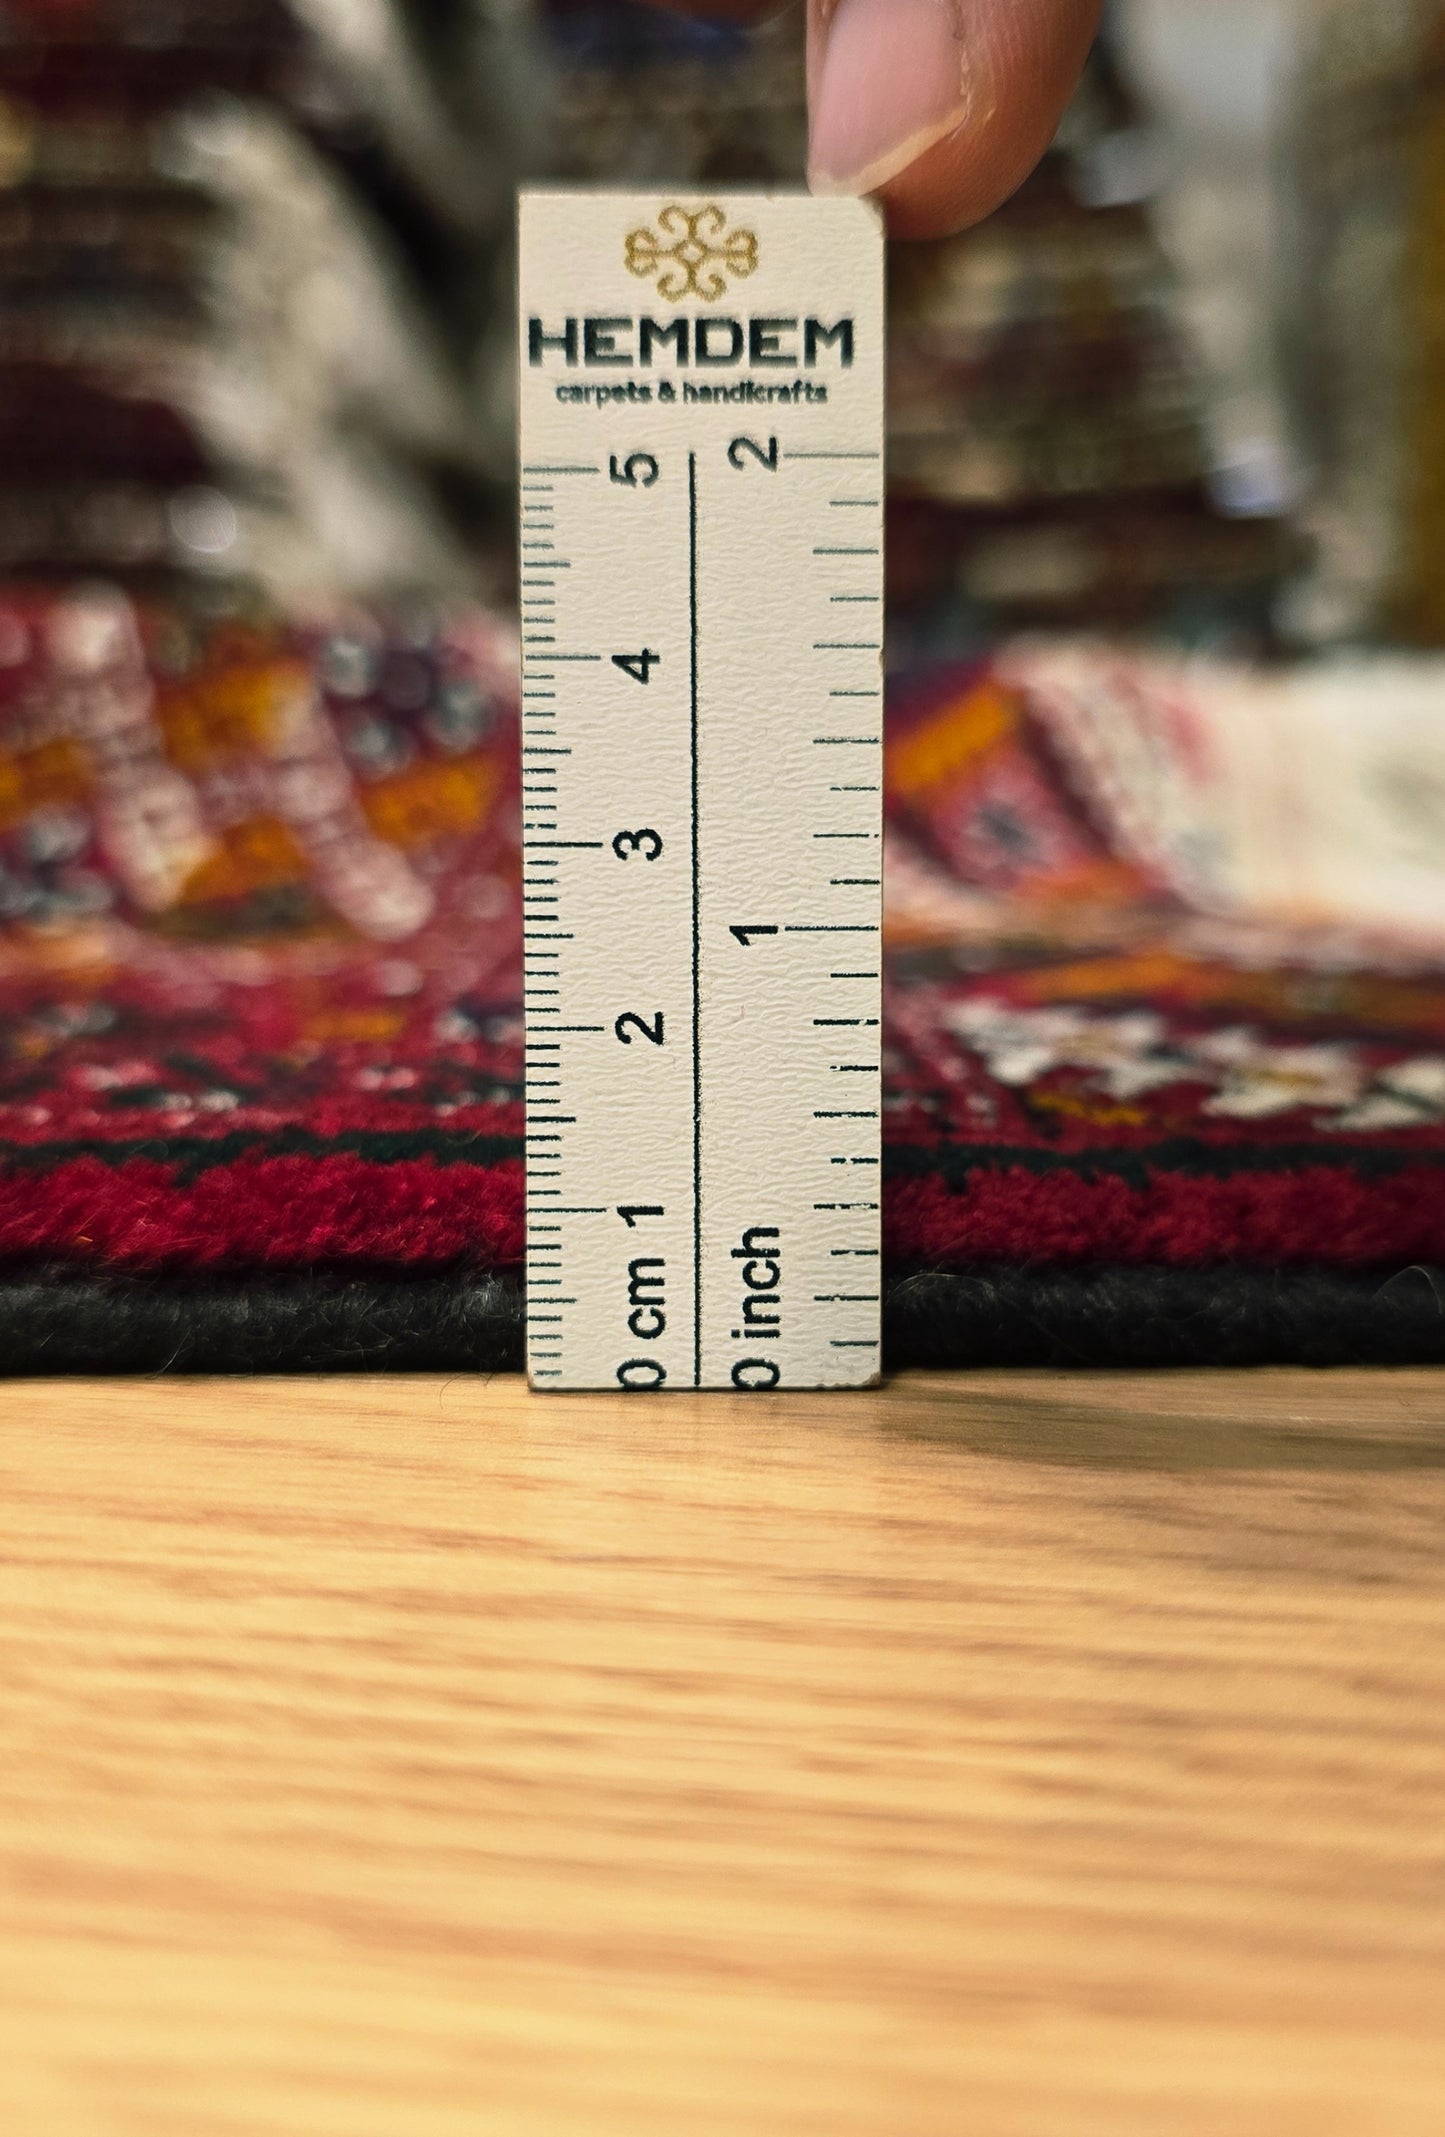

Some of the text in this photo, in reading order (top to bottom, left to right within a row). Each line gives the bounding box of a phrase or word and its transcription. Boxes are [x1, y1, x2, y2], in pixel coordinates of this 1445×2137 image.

[528, 318, 855, 368] HEMDEM
[556, 380, 828, 408] carpets & handicrafts
[609, 452, 660, 488] 5
[727, 436, 778, 472] 2
[611, 648, 660, 685] 4
[612, 828, 664, 861] 3
[729, 925, 779, 947] 1
[614, 1011, 665, 1045] 2
[616, 1205, 665, 1228] 1
[616, 1257, 667, 1388] 0 cm
[730, 1226, 782, 1388] 0 inch
